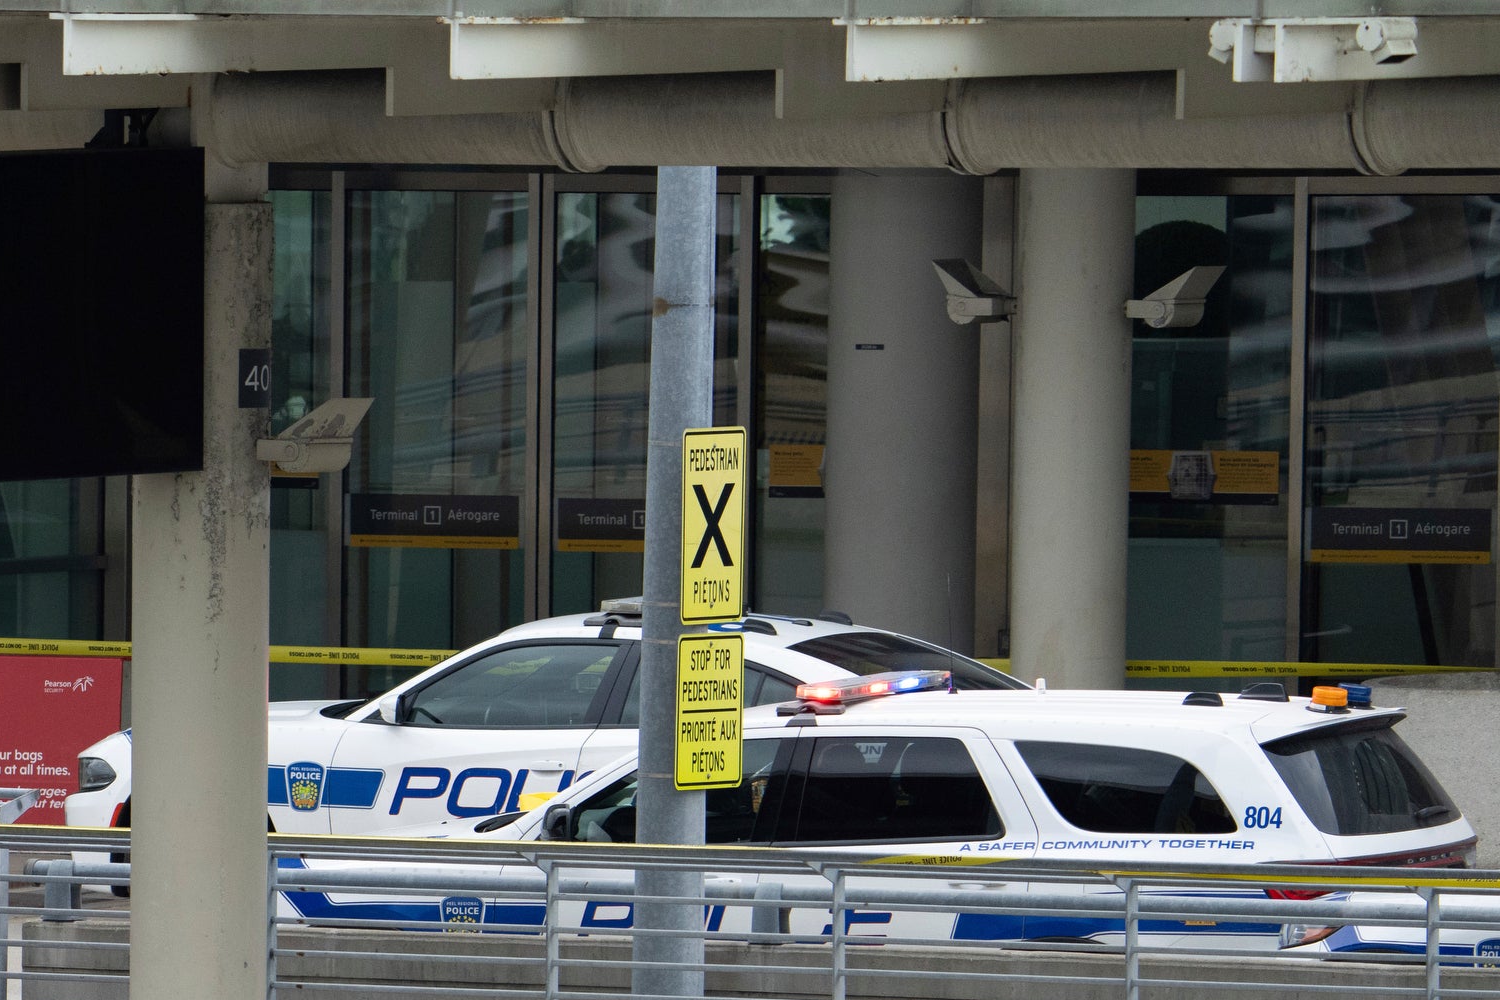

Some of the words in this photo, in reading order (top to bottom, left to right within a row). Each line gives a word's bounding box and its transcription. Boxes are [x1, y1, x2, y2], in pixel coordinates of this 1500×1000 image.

[244, 364, 270, 392] 40
[690, 448, 739, 472] PEDESTRIAN
[370, 508, 418, 520] Terminal
[448, 508, 500, 524] Aérogare
[577, 513, 627, 526] Terminal
[1332, 522, 1383, 534] Terminal
[1415, 523, 1471, 537] Aérogare
[694, 578, 730, 604] PIÉTONS
[690, 650, 710, 671] STOP
[714, 649, 730, 670] FOR
[44, 680, 71, 688] Pearson
[682, 679, 738, 702] PEDESTRIANS
[681, 717, 716, 743] PRIORITÉ
[720, 720, 737, 740] AUX
[15, 749, 43, 762] bags
[692, 749, 725, 773] PIÉTONS
[4, 764, 15, 775] at
[20, 764, 33, 775] all
[37, 764, 71, 776] times.
[290, 772, 321, 781] POLICE
[1244, 806, 1282, 830] 804
[960, 844, 971, 852] A
[978, 842, 1035, 851] SAFER
[1042, 840, 1152, 850] COMMUNITY
[1158, 840, 1255, 850] TOGETHER
